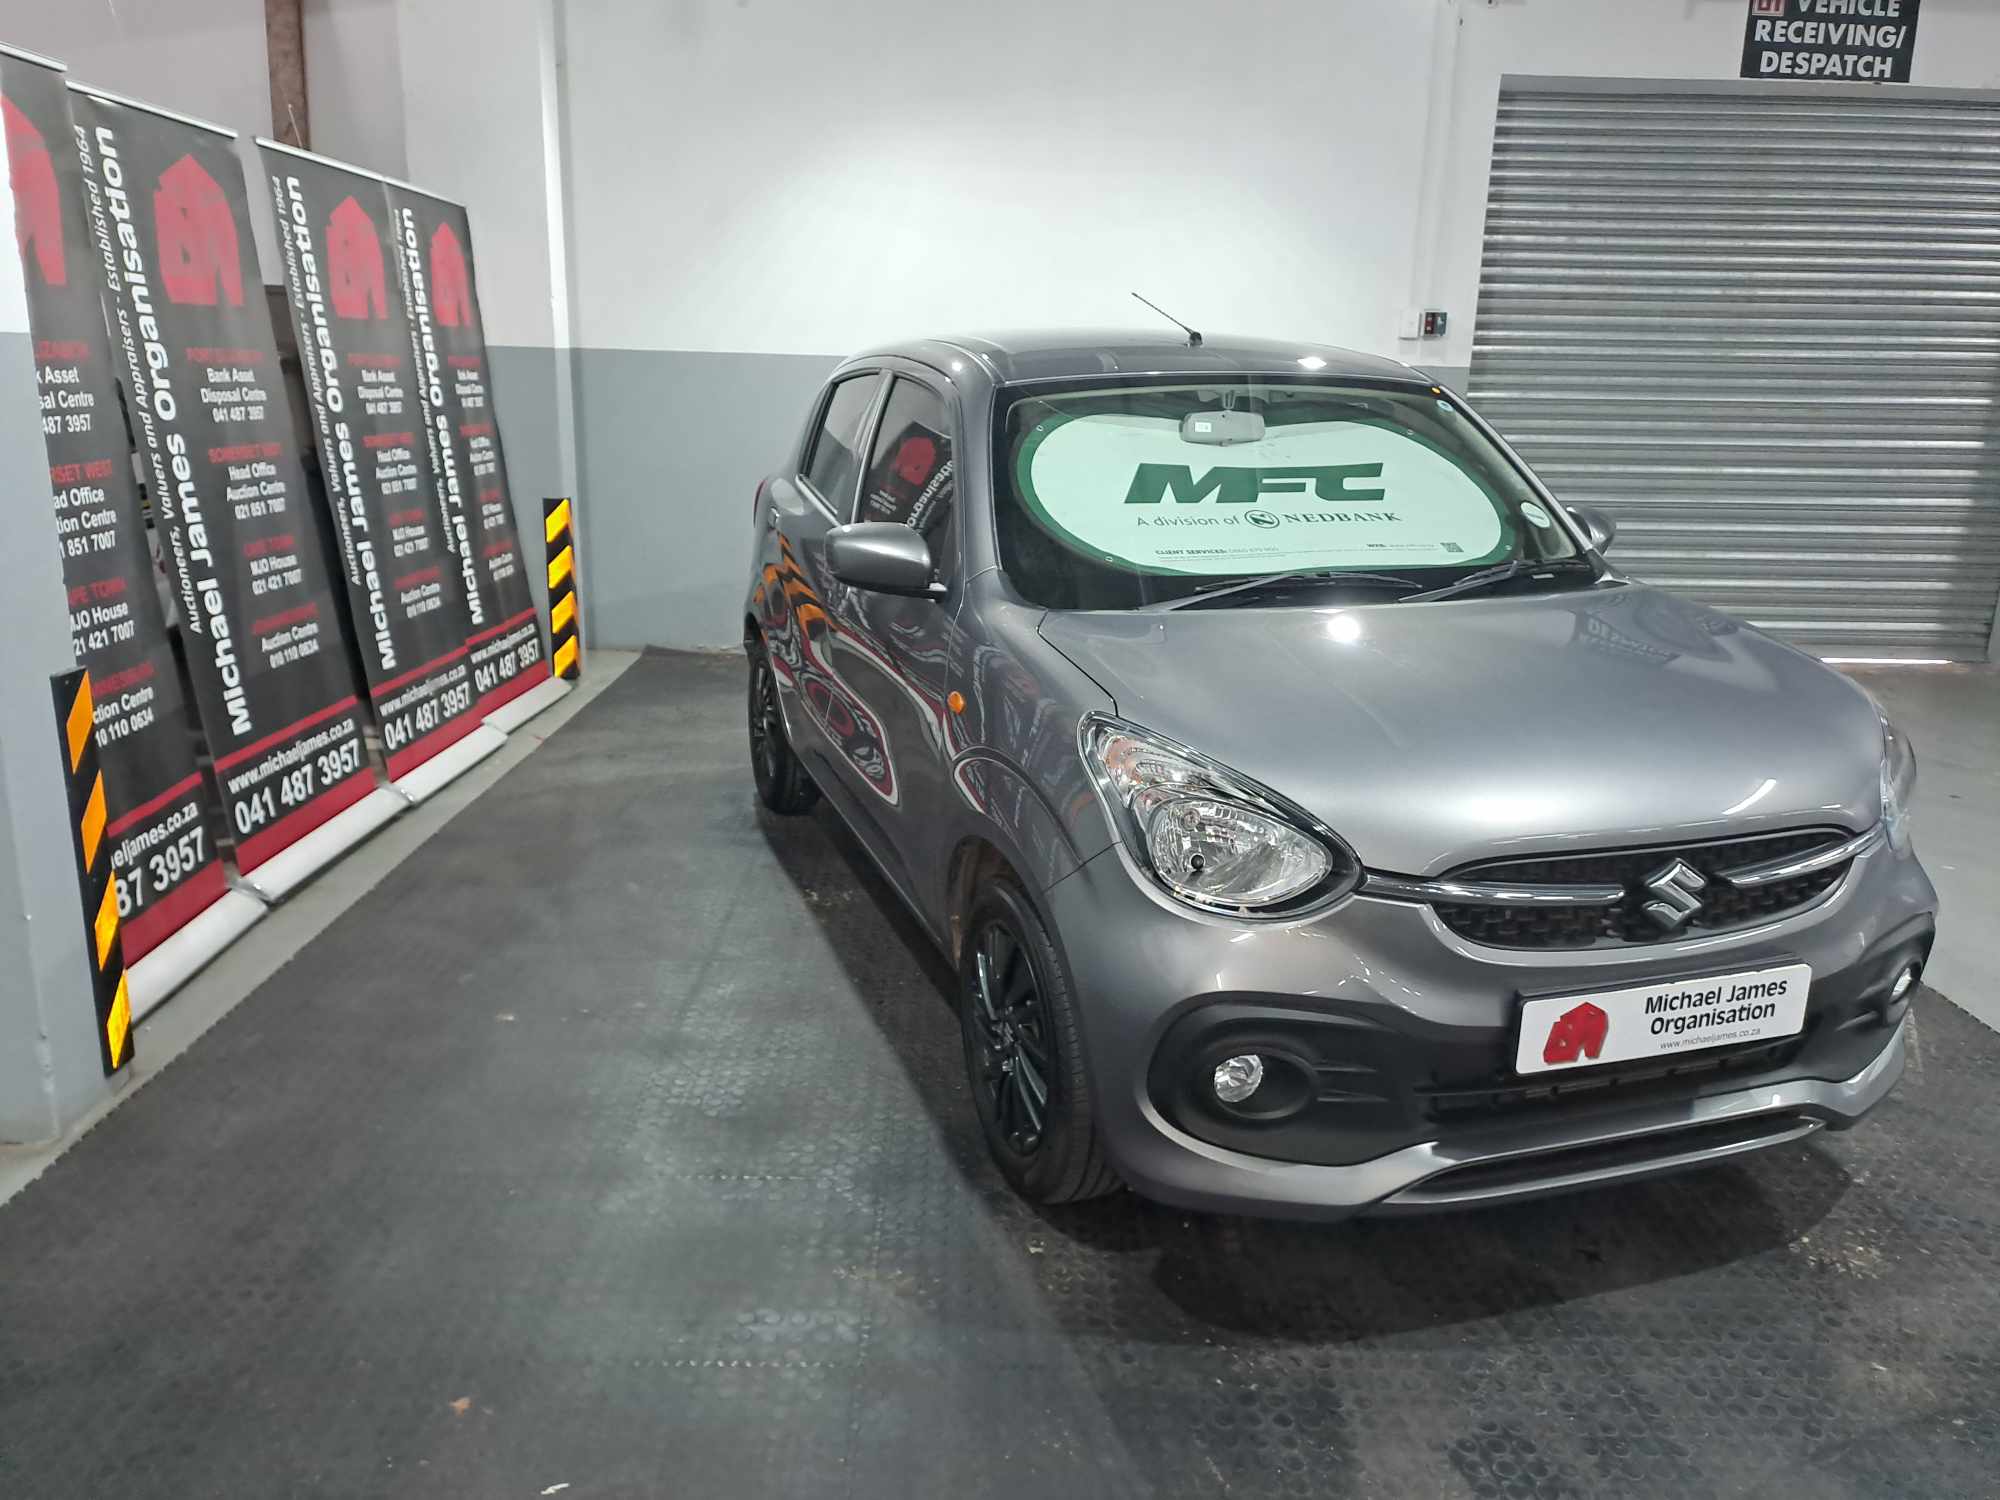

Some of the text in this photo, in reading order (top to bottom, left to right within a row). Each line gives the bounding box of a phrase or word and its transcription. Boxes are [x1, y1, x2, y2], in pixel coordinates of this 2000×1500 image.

[1798, 0, 1900, 18] VEHICLE
[1754, 19, 1907, 49] RECEIVING/
[1760, 51, 1893, 79] DESPATCH
[74, 125, 94, 174] 1964
[84, 178, 120, 292] Established
[45, 366, 79, 383] Asset
[117, 308, 148, 408] Appraisers
[58, 390, 94, 408] Centre
[65, 413, 91, 432] 3957
[96, 127, 252, 735] Michael James Organisation
[138, 411, 158, 449] and
[286, 176, 396, 670] Michael James Organisation
[402, 208, 484, 624] Michael James Organisation
[70, 486, 104, 506] Office
[151, 453, 174, 519] Valuers
[1124, 462, 1385, 504] MFC
[81, 509, 116, 528] Centre
[1137, 512, 1403, 527] A division of NEDBANK
[67, 536, 88, 557] 851
[91, 530, 116, 551] 7007
[91, 602, 128, 624] House
[88, 629, 109, 650] 421
[110, 620, 134, 643] 7007
[474, 637, 540, 692] 041 487 3957
[108, 718, 129, 740] 110
[384, 681, 471, 750] 041 487 3957
[234, 737, 360, 834] 041 487 3957
[149, 825, 203, 891] 3957
[1644, 980, 1788, 1014] Michael James
[1650, 1002, 1776, 1035] Organisation
